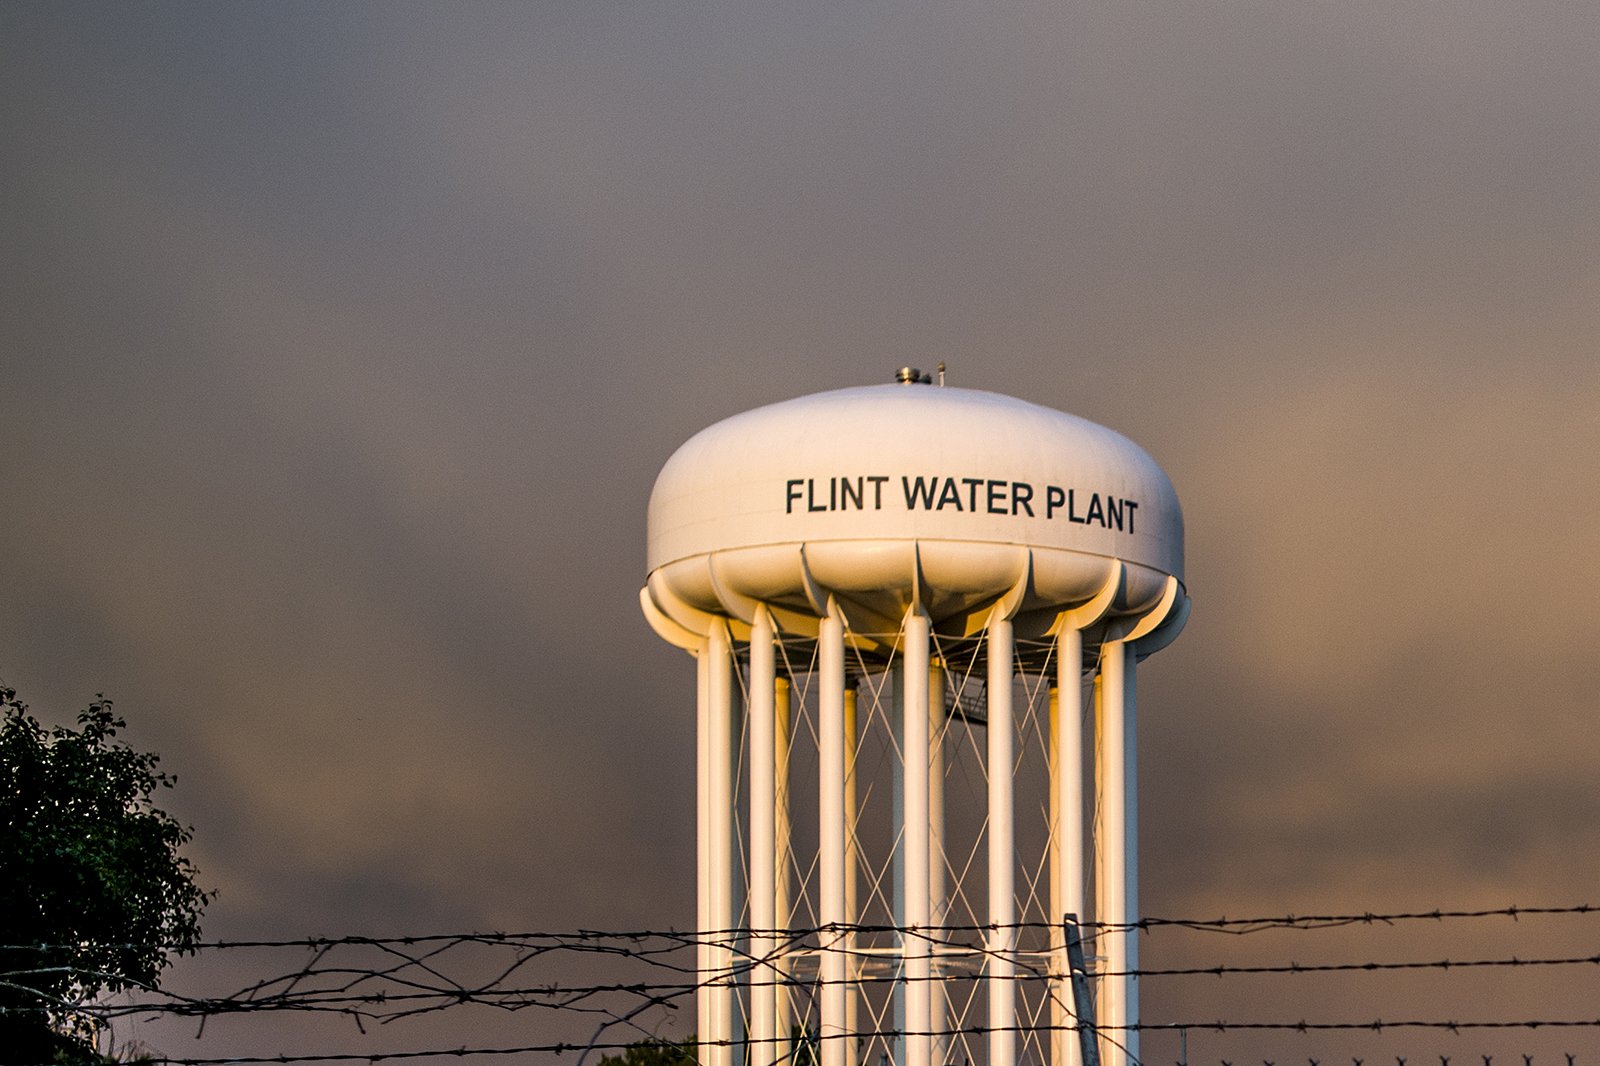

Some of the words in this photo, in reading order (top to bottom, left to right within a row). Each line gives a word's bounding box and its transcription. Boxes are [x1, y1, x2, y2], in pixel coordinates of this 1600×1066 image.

[786, 476, 890, 514] FLINT
[901, 476, 1035, 518] WATER
[1046, 485, 1139, 535] PLANT
